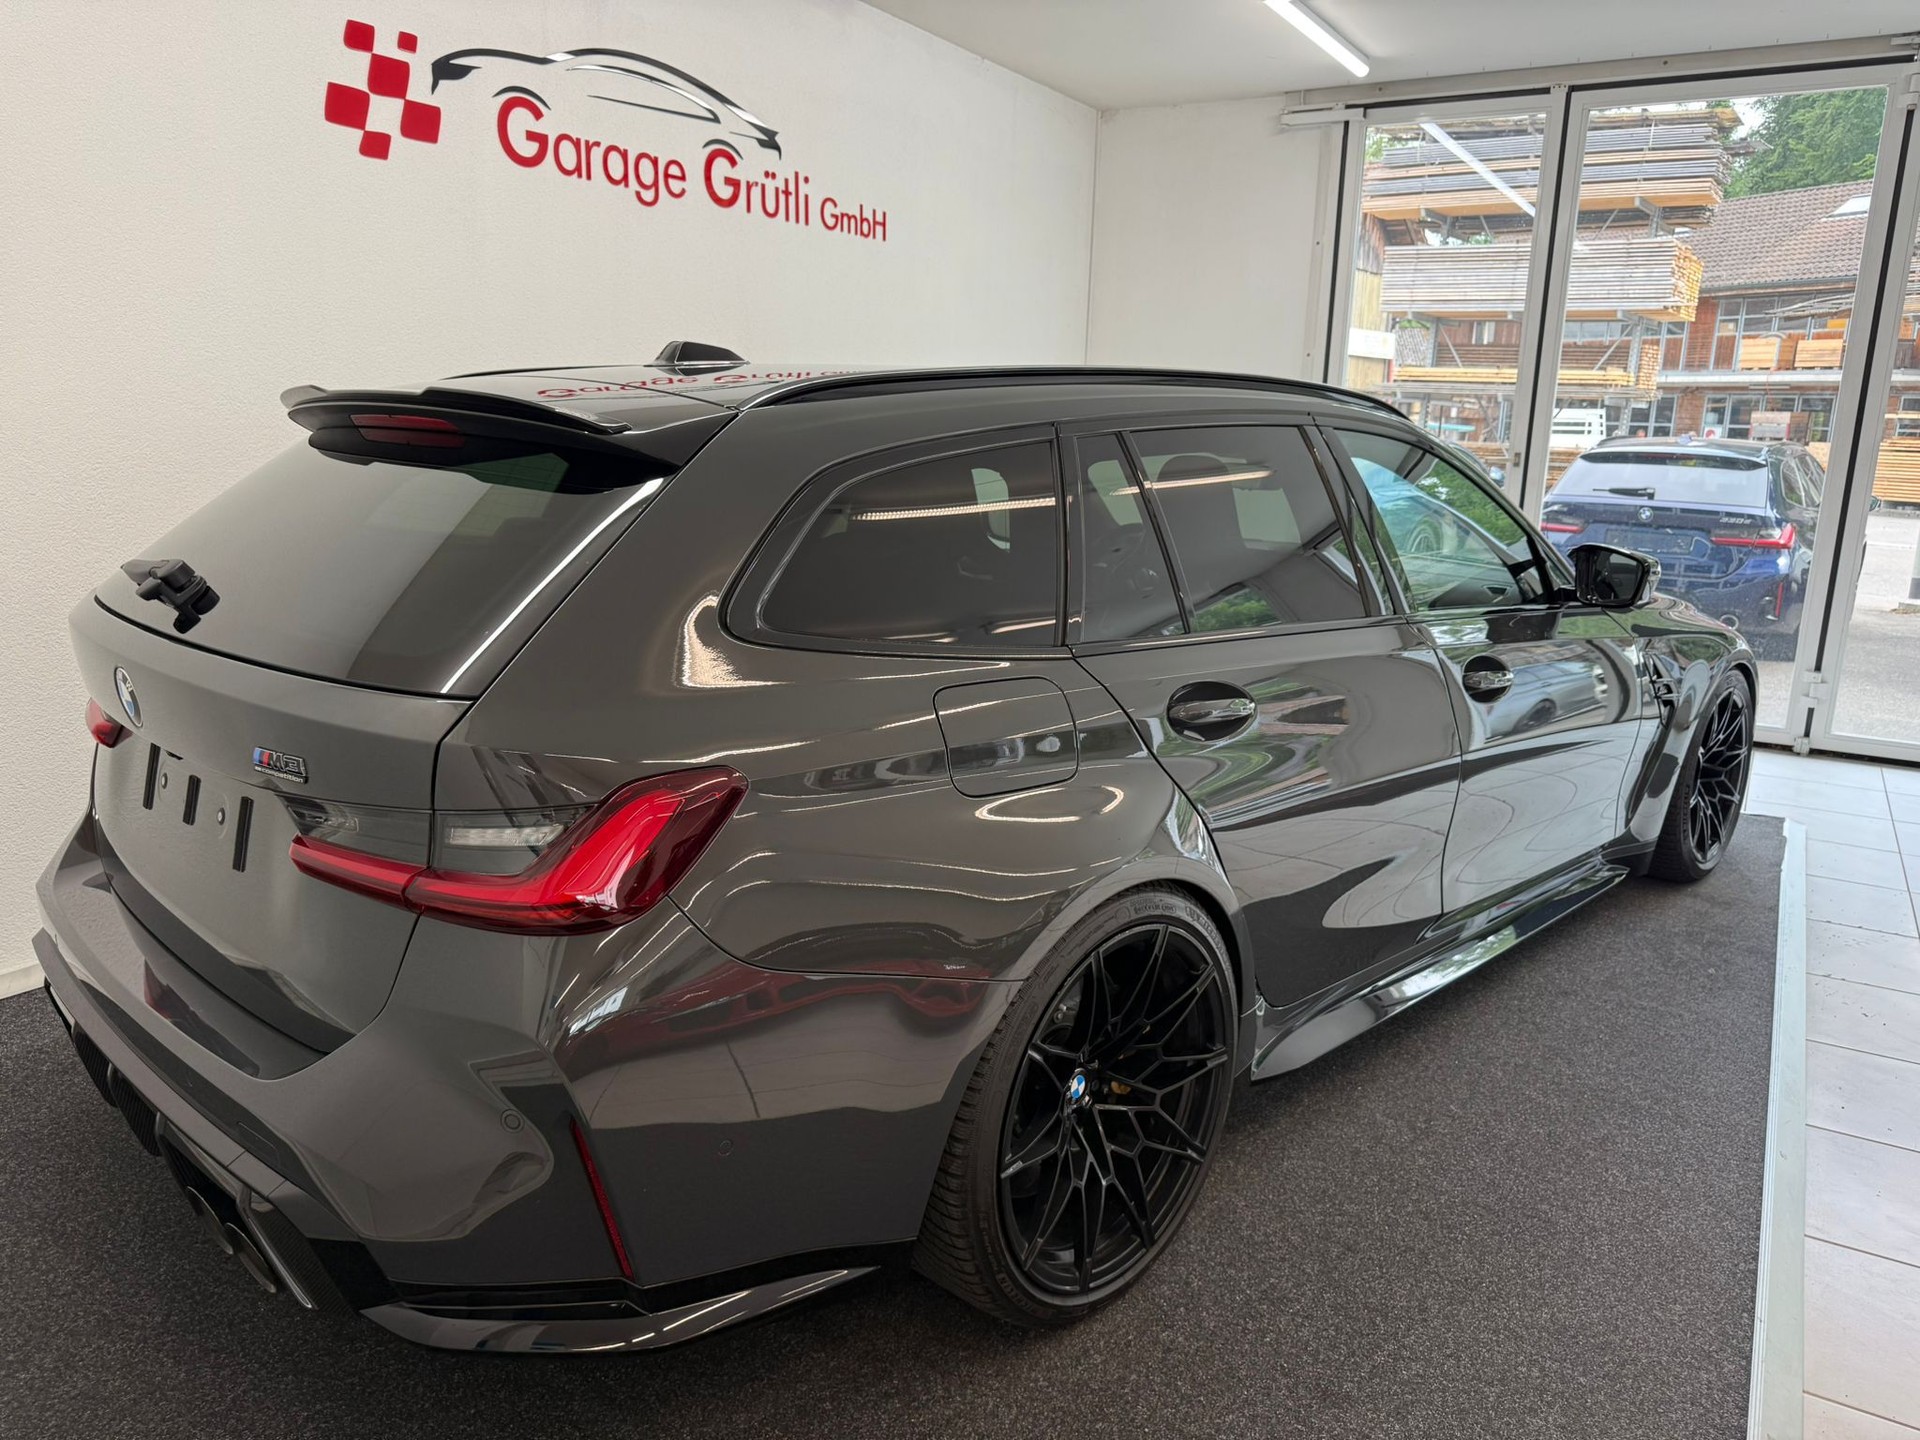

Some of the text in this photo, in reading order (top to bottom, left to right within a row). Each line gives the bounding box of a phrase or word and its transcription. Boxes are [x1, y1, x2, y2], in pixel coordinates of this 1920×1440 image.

[496, 96, 887, 241] Garage Grütli GmbH
